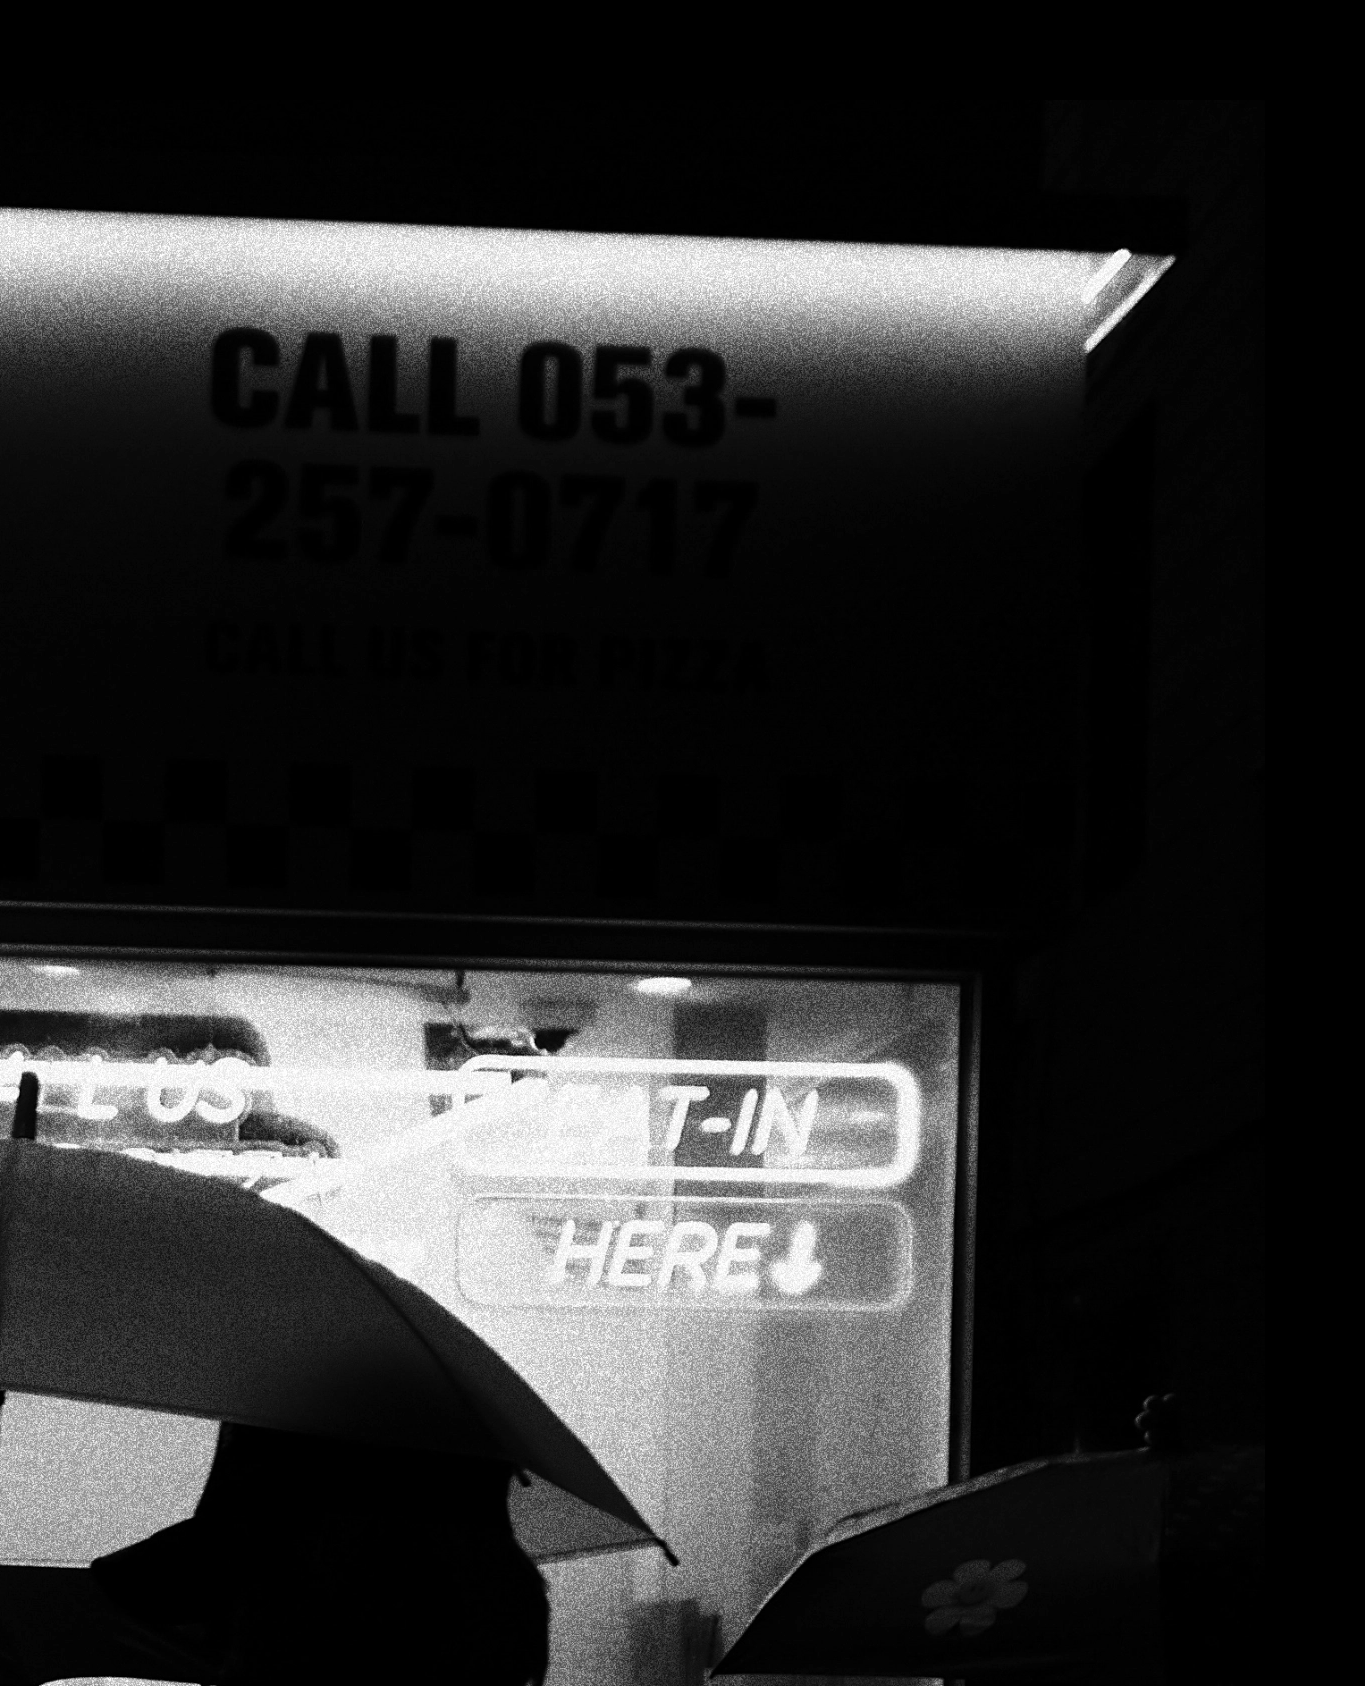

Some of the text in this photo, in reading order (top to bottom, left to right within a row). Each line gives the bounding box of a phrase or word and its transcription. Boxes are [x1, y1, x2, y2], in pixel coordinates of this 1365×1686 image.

[211, 327, 778, 446] CALL 053-
[224, 459, 758, 579] 257-0717
[205, 620, 771, 695] CALL US FOR PIZZA
[145, 1055, 251, 1123] US
[551, 1219, 772, 1294] HERE
